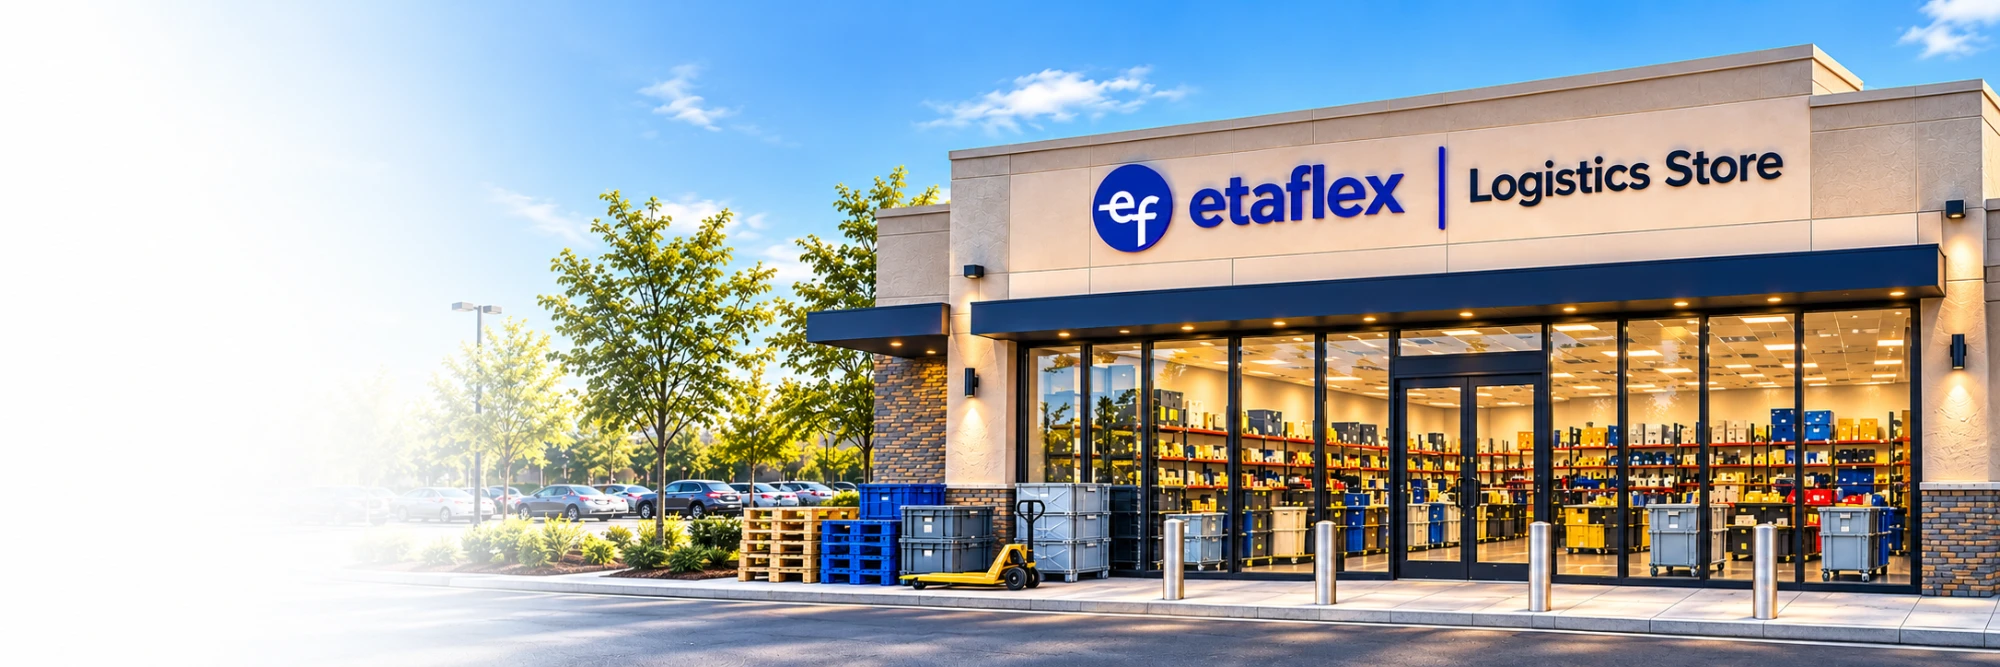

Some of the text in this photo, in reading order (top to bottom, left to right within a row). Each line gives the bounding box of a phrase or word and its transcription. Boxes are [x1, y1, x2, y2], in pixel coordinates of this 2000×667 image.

[1189, 163, 1405, 229] etaflex
[1469, 149, 1784, 208] Logistics Store
[1098, 190, 1159, 247] ef
